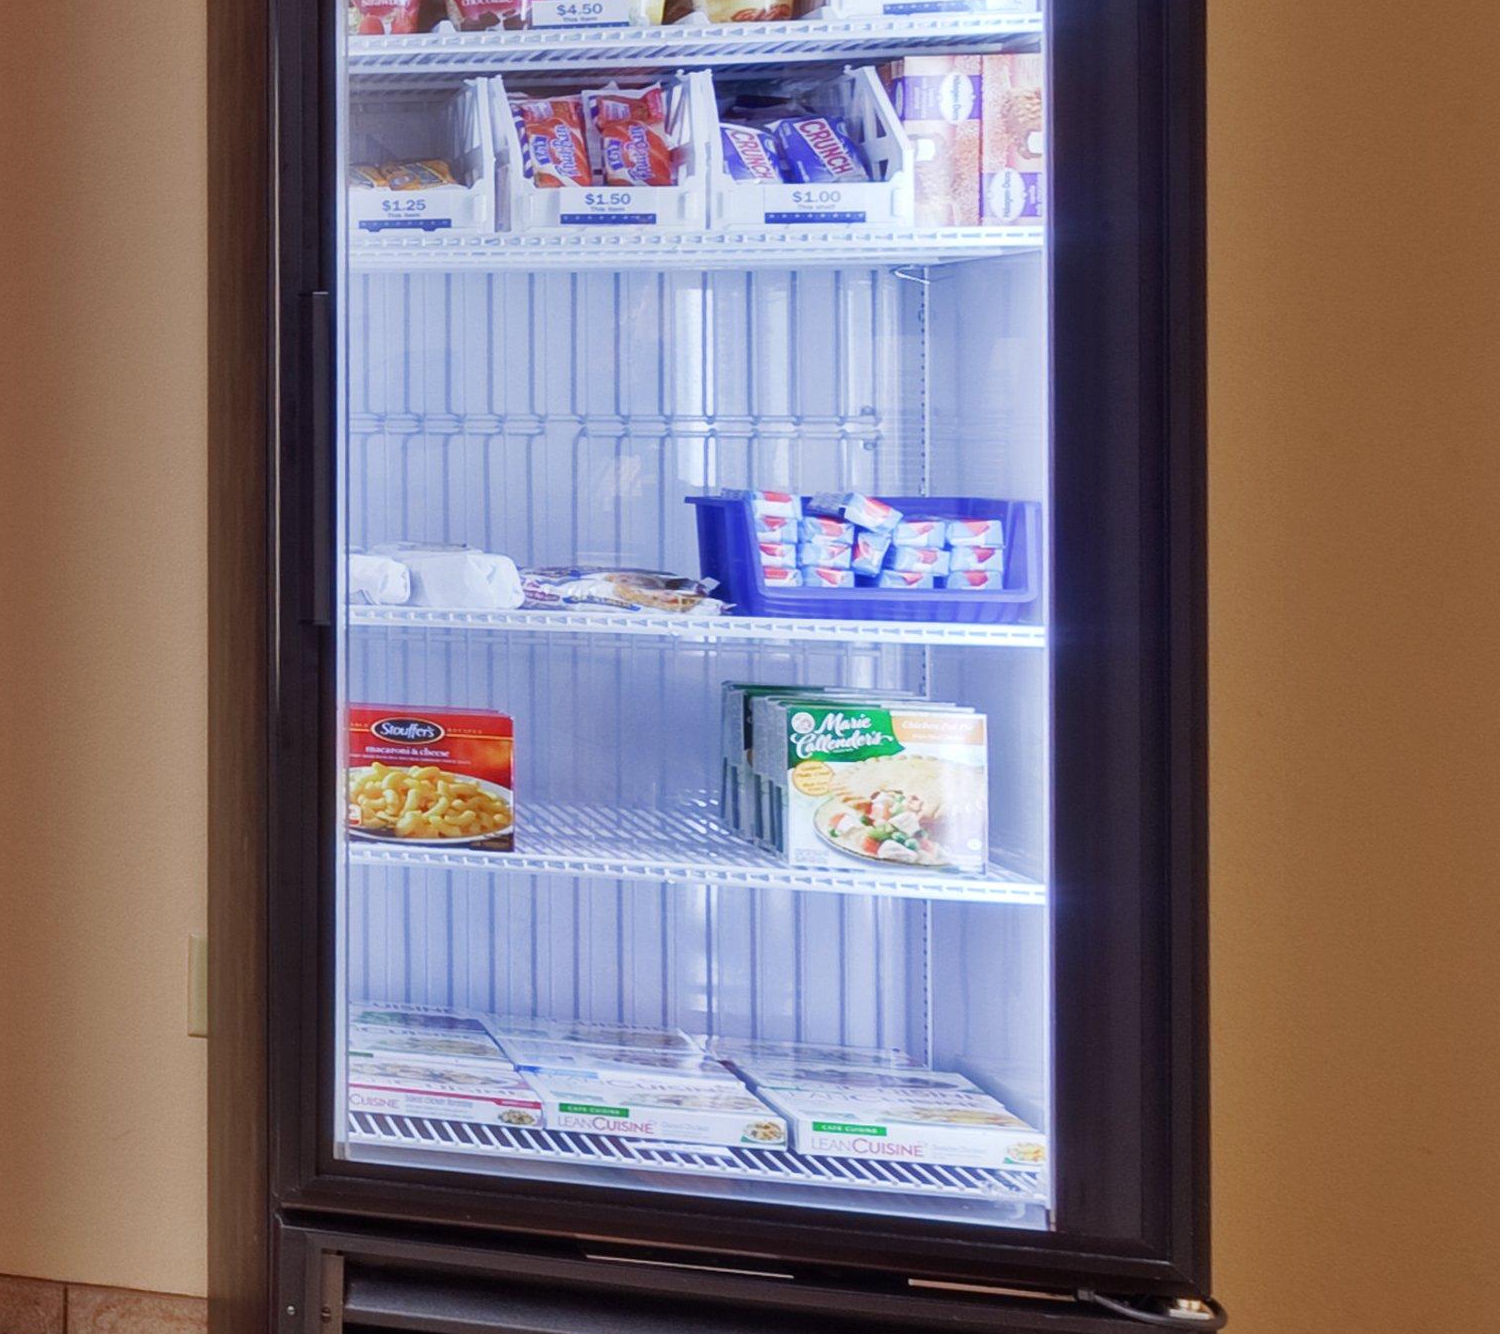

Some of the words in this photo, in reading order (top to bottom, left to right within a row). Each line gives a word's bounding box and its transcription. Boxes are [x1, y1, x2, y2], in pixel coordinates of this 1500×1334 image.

[557, 3, 603, 16] $4.50
[799, 119, 854, 175] CRUNCH
[731, 130, 775, 180] CRUNCH
[584, 193, 631, 206] $1.50
[792, 191, 841, 203] $1.00
[382, 199, 426, 212] $1.25
[380, 722, 435, 739] Stouffer's
[816, 712, 872, 734] Marie
[365, 745, 410, 755] macaroni
[420, 748, 450, 758] cheese
[790, 729, 894, 759] Callender's
